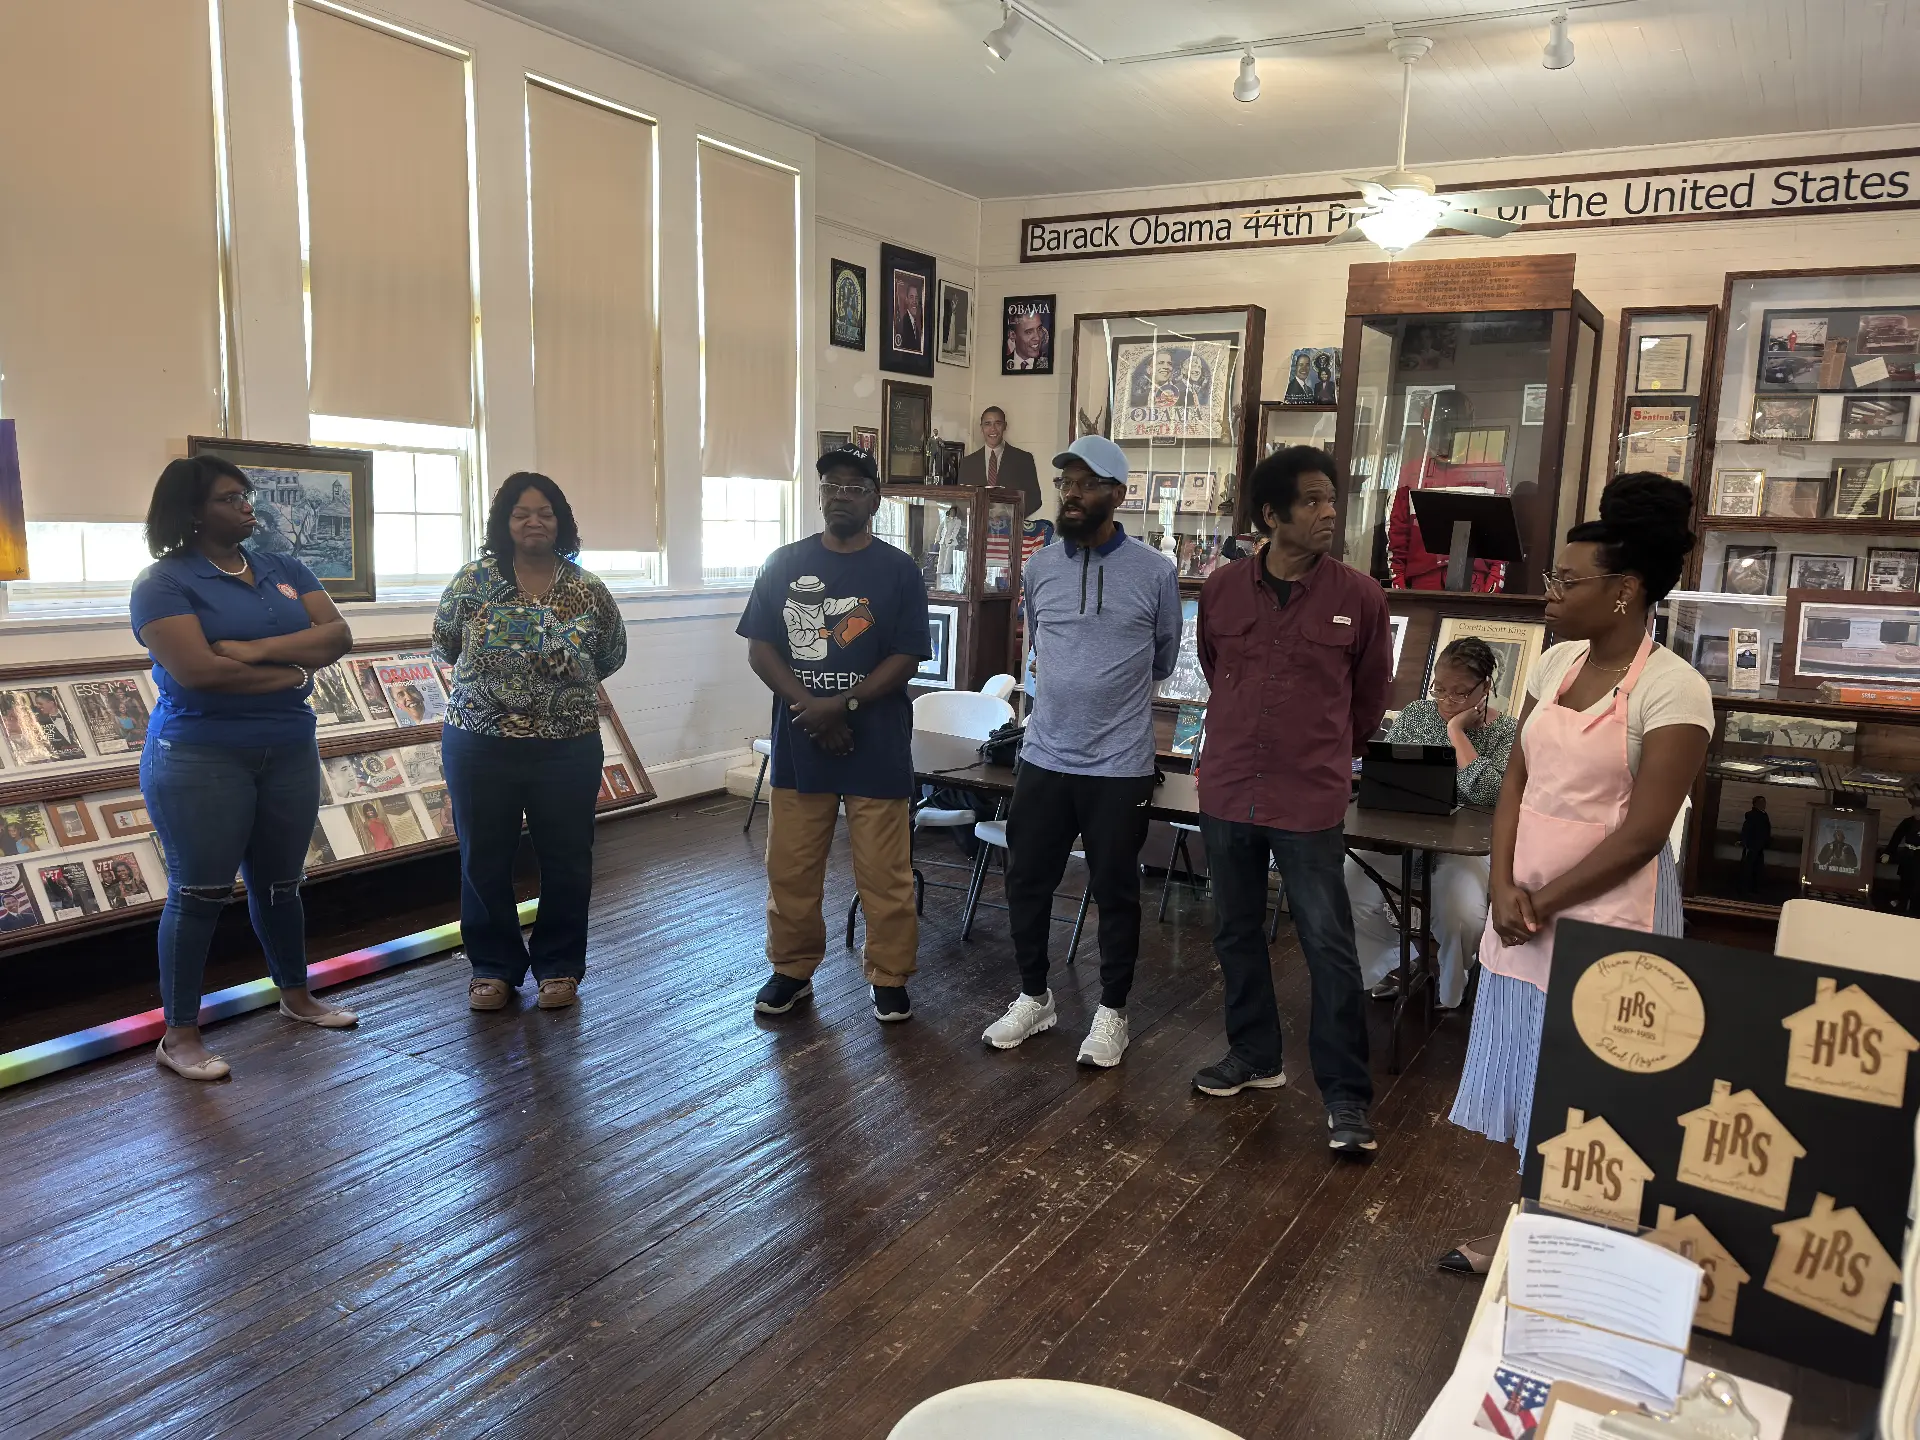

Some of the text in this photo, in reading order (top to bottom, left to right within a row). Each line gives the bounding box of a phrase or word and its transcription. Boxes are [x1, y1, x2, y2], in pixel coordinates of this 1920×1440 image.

[1028, 218, 1120, 252] Barack
[1129, 215, 1231, 246] Obama
[1243, 206, 1313, 239] 44th
[1548, 185, 1607, 220] the
[1624, 173, 1754, 215] United
[1772, 167, 1910, 206] States
[1008, 303, 1050, 316] OBAMA
[1458, 622, 1528, 637] Coretta Scott King
[379, 665, 435, 683] OBAMA
[96, 860, 114, 873] JET
[1617, 990, 1657, 1028] HRS
[1811, 1009, 1884, 1076] HRS
[1702, 1112, 1772, 1178] HRS
[1561, 1139, 1624, 1202] HRS
[1793, 1229, 1872, 1298] HRS
